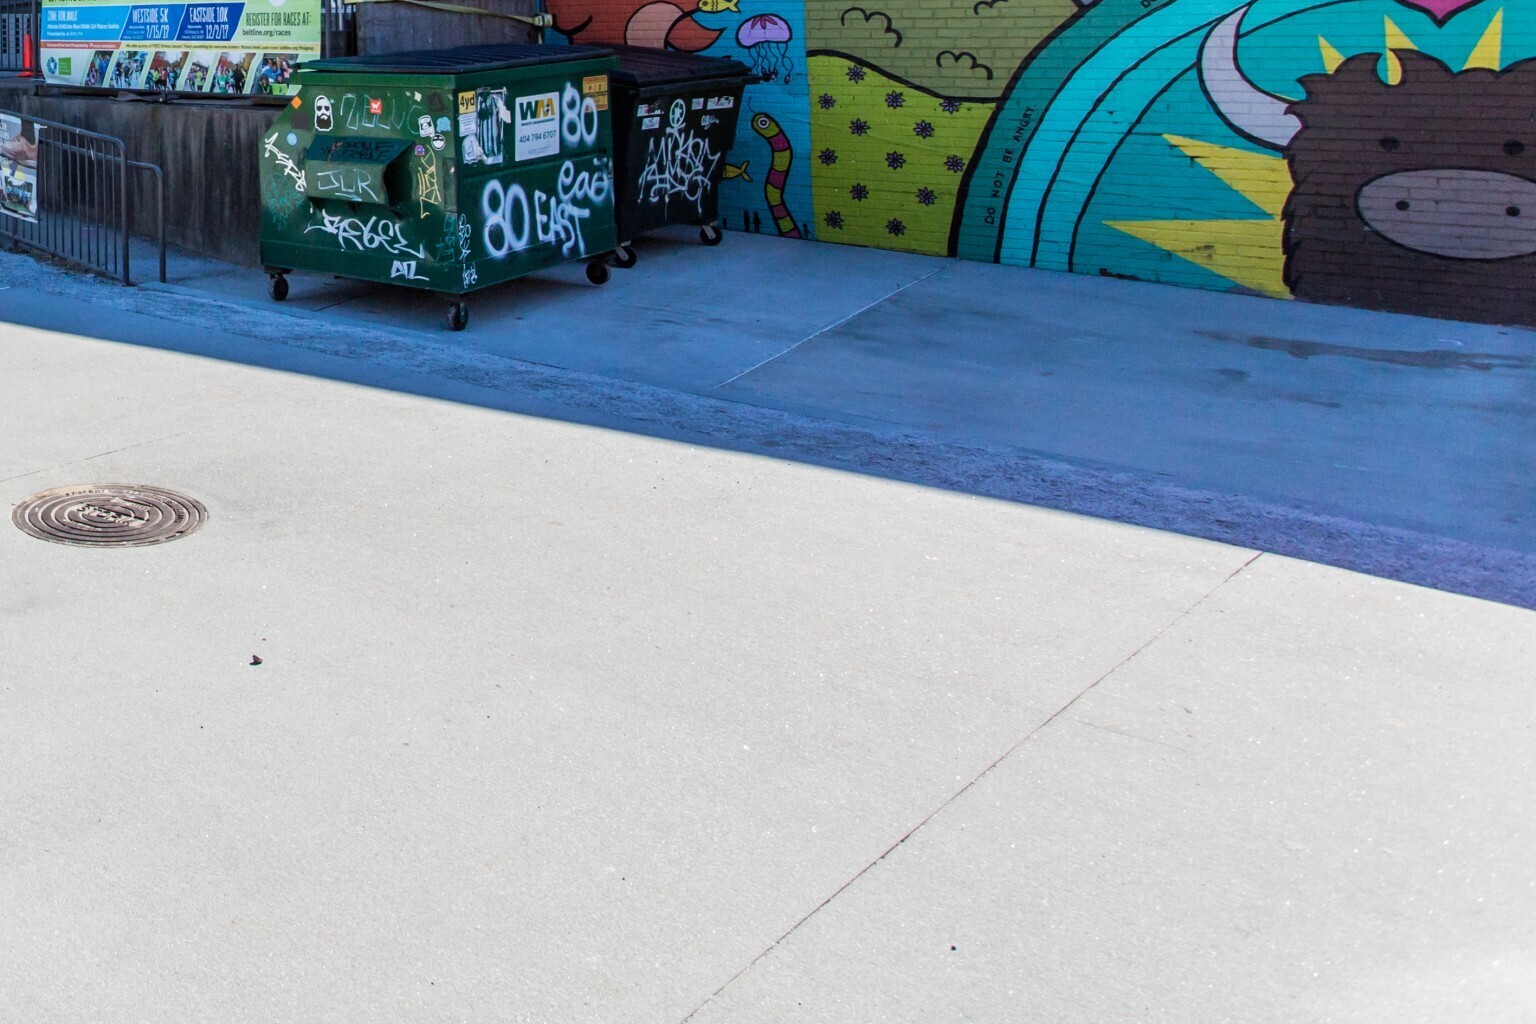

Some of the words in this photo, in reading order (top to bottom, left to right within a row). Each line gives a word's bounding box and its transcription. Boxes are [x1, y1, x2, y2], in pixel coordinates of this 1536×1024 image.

[133, 8, 159, 23] WESTSIDE
[160, 8, 169, 23] 5K
[189, 7, 215, 23] EASTSIDE
[216, 7, 229, 23] 10K
[246, 12, 269, 26] REGISTER
[271, 12, 281, 26] FOR
[283, 12, 300, 26] RACES
[302, 12, 311, 26] AT:
[146, 25, 170, 39] 7/15/17
[205, 24, 229, 39] 12/2/17
[243, 28, 292, 37] beltline.org/races
[460, 92, 475, 111] 4yd
[519, 97, 555, 121] WM
[562, 82, 598, 146] 80
[519, 133, 530, 143] 404
[531, 131, 542, 142] 794
[543, 129, 557, 141] 6707
[984, 207, 996, 225] DO
[991, 171, 1006, 198] NOT
[1002, 148, 1014, 163] BE
[483, 179, 530, 260] 80
[534, 189, 591, 258] EAST
